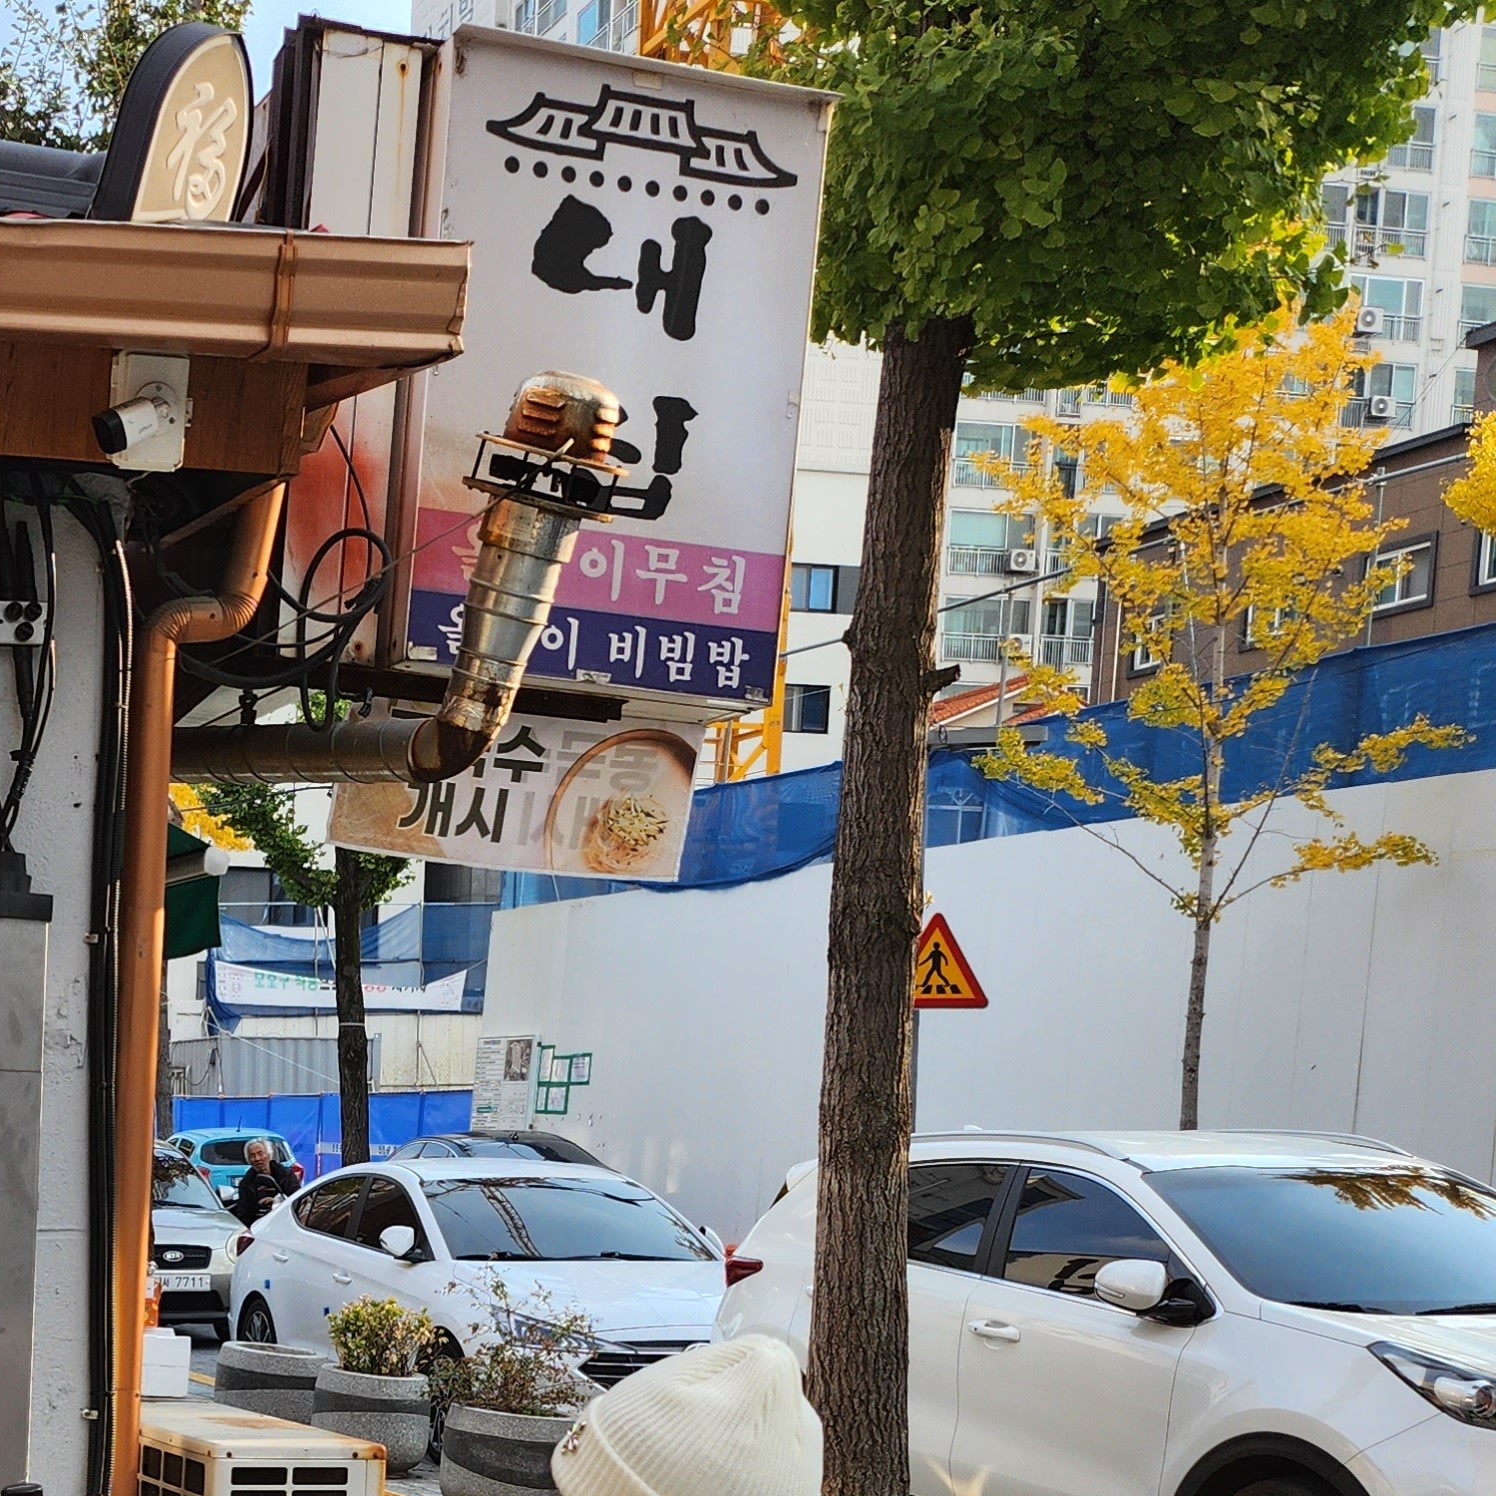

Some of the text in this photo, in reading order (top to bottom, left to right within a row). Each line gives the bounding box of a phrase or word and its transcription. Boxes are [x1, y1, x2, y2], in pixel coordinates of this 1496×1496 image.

[607, 625, 751, 690] 비빔밥
[397, 780, 509, 843] 개시
[175, 1276, 203, 1288] 7711
